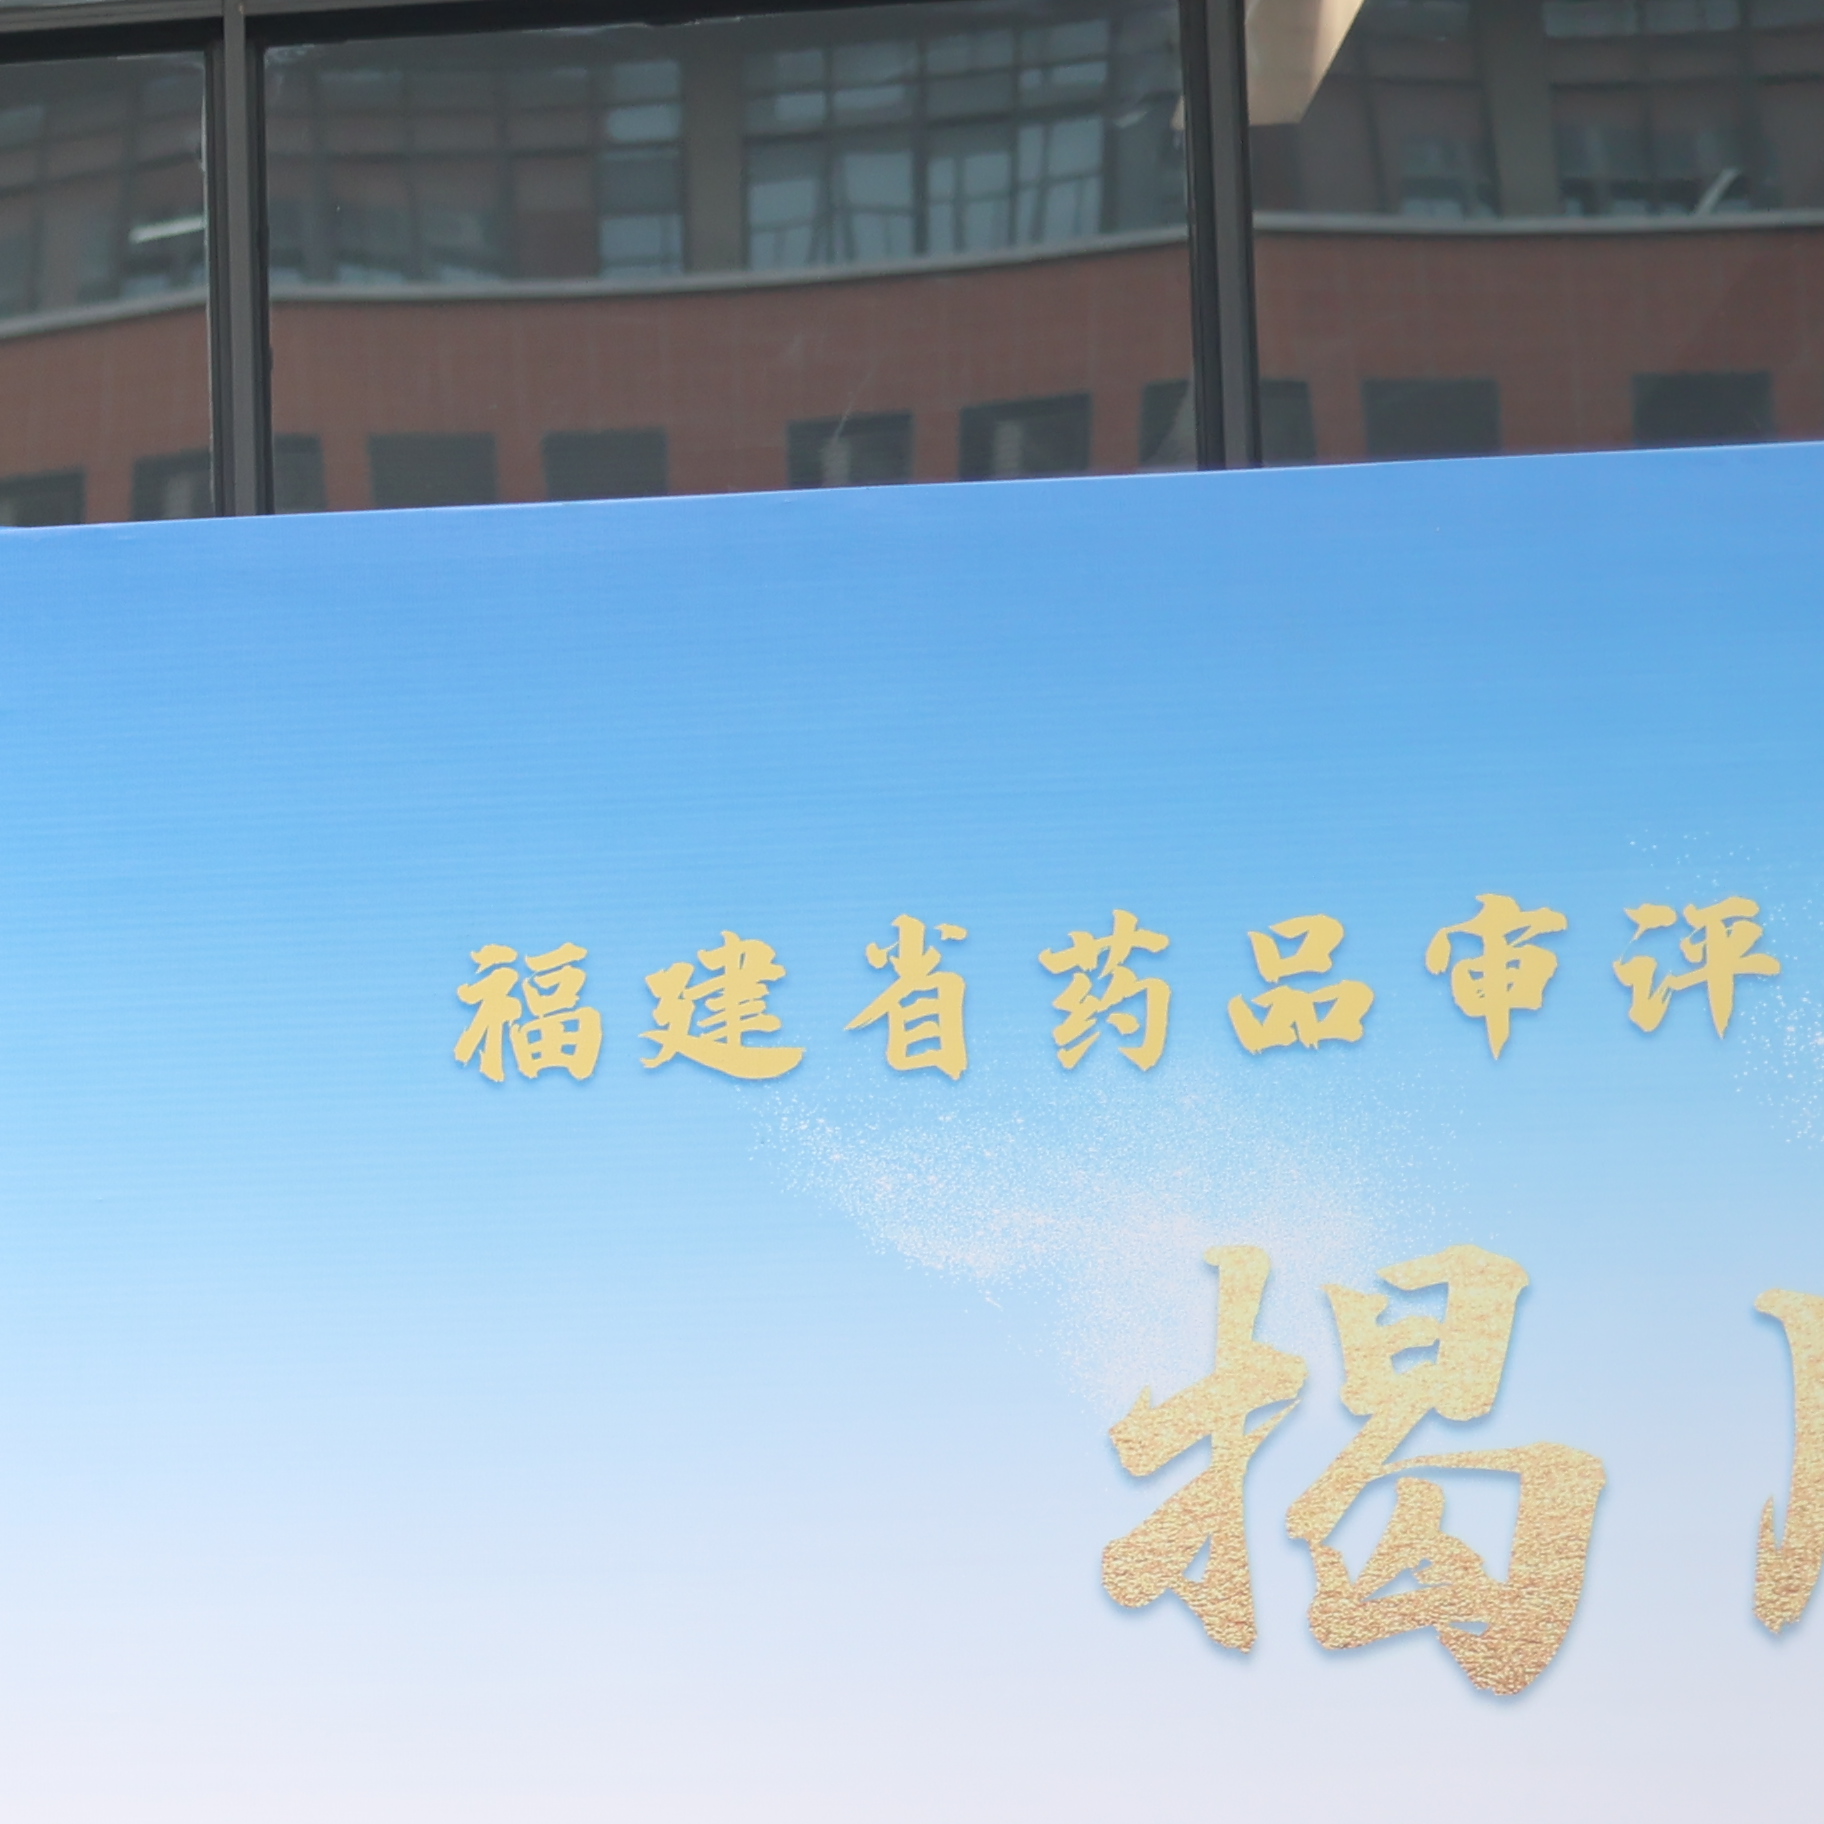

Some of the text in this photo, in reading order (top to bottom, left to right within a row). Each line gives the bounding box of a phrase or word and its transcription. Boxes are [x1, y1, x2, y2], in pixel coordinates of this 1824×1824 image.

[453, 893, 1783, 1083] 福建省药品审评
